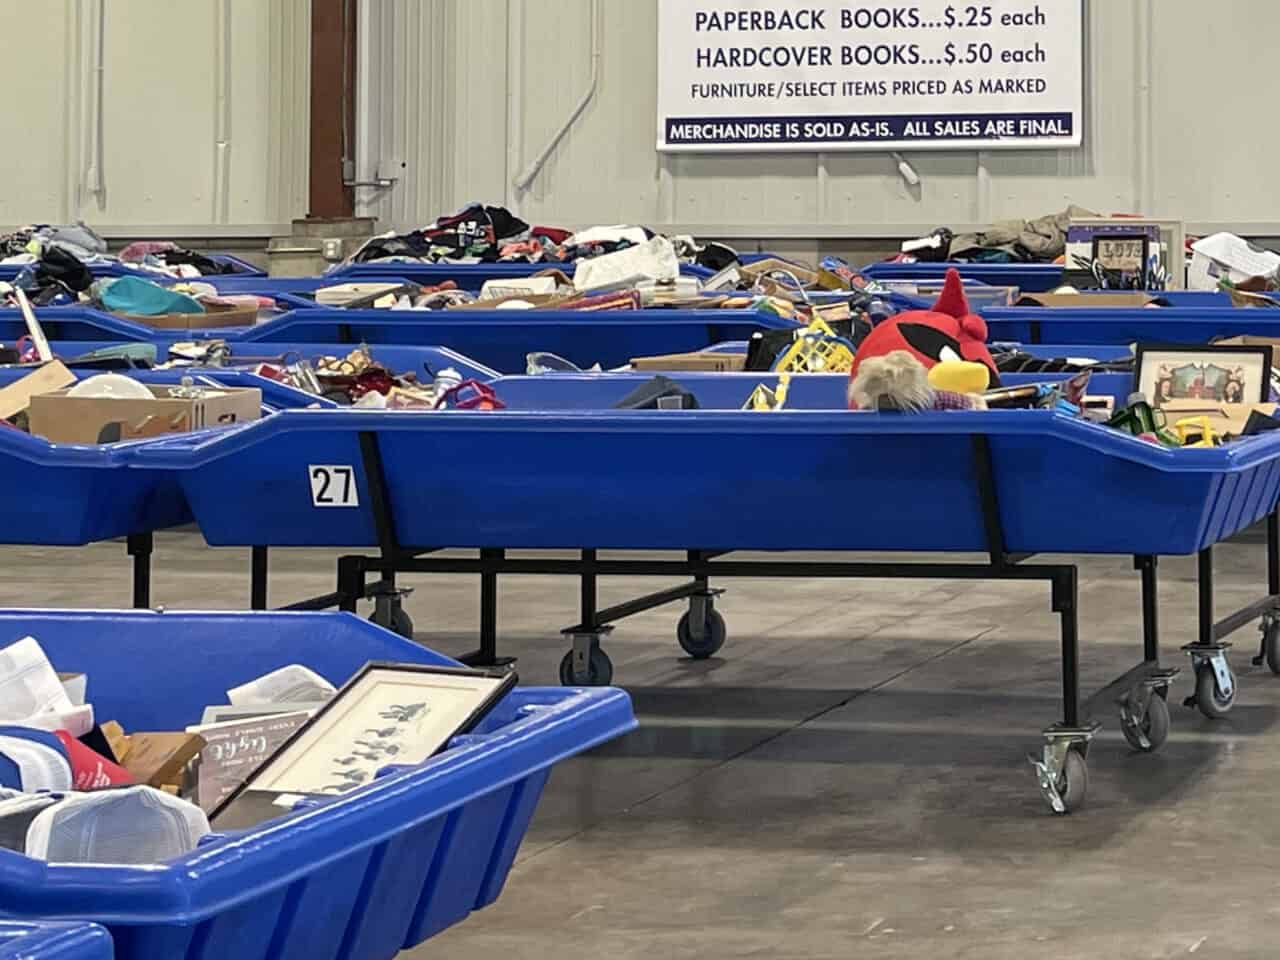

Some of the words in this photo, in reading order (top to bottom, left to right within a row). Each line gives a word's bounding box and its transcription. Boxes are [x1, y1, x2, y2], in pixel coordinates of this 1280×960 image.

[696, 10, 825, 31] PAPERBACK
[1001, 5, 1045, 26] each
[697, 46, 832, 68] HARDCOVER
[1001, 42, 1045, 63] each
[692, 82, 836, 98] FURNITURE/SELECT
[843, 81, 886, 96] ITEMS
[893, 80, 946, 95] PRICED
[952, 80, 973, 94] AS
[979, 79, 1046, 93] MARKED
[671, 124, 780, 138] MERCHANDISE
[786, 123, 799, 137] IS
[805, 123, 844, 137] SOLD
[849, 122, 893, 136] AS-IS.
[904, 122, 930, 136] ALL
[935, 121, 979, 136] SALES
[984, 121, 1014, 136] ARE
[1020, 120, 1070, 136] FINAL.
[313, 468, 351, 503] 27
